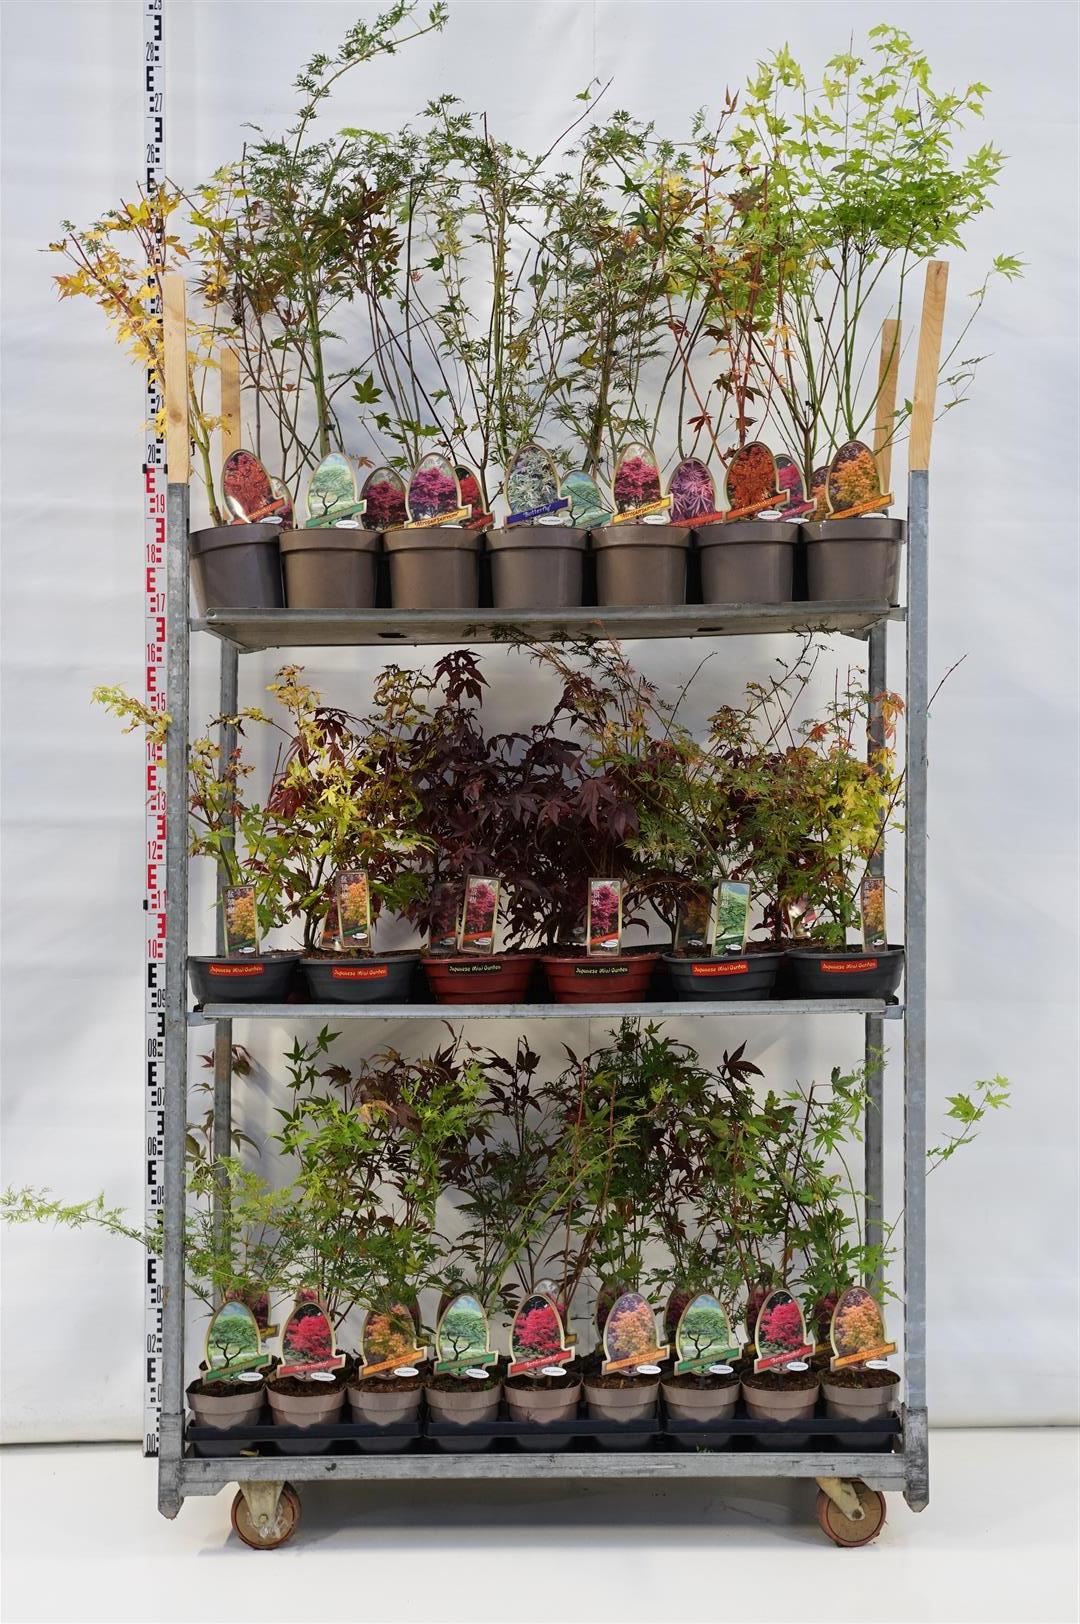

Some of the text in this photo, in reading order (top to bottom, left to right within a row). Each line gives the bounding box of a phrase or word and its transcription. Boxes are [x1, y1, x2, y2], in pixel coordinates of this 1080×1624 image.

[146, 42, 154, 61] 28
[155, 93, 163, 112] 27
[147, 144, 155, 163] 26
[148, 444, 156, 463] 20
[156, 494, 165, 513] 19
[147, 544, 156, 563] 18
[156, 594, 165, 612] 17
[147, 643, 156, 662] 16
[157, 692, 166, 711] 15
[147, 742, 156, 761] 14
[157, 791, 166, 810] 13
[148, 841, 157, 860] 12
[157, 890, 167, 908] 11
[148, 939, 157, 958] 10
[148, 1039, 157, 1057] 08
[148, 1137, 157, 1155] 06
[147, 1334, 156, 1353] 02
